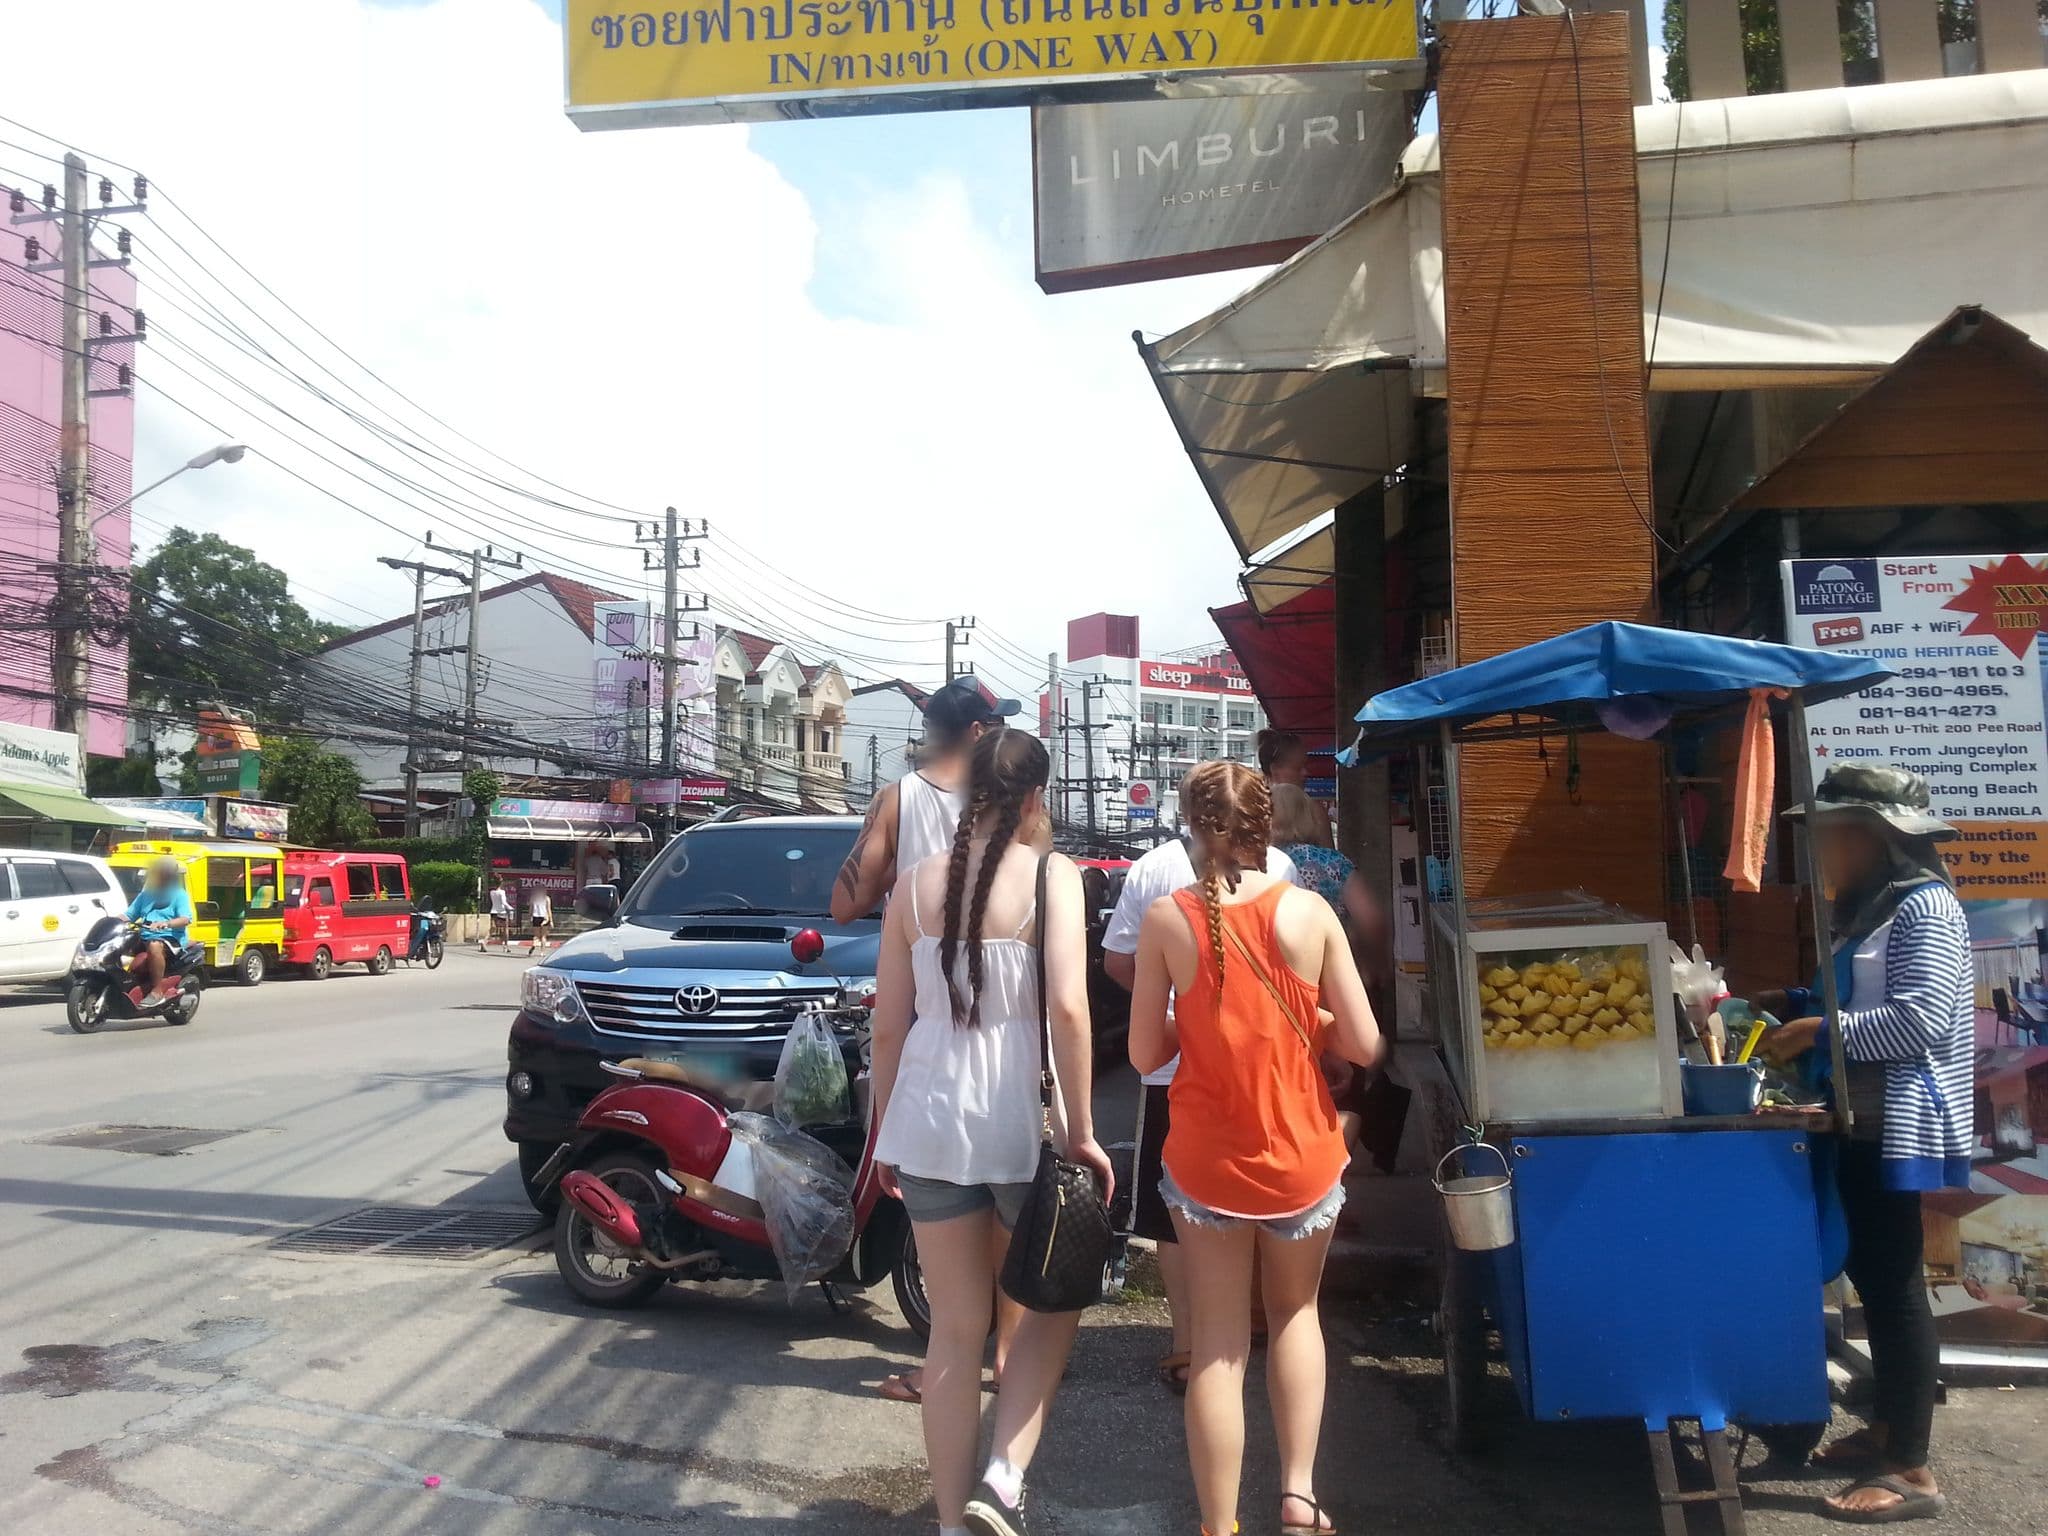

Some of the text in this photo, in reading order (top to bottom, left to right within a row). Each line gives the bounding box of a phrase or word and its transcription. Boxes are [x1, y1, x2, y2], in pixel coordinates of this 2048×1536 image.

[591, 0, 955, 49] ซอยฟาประทาน
[964, 37, 1074, 77] (ONE
[1094, 29, 1217, 66] WAY)
[1070, 109, 1366, 187] LIMBURI
[1162, 180, 1280, 207] HOMETEL
[1884, 563, 1938, 577] Start
[1809, 582, 1865, 594] PATONG
[1903, 581, 1953, 594] From
[1800, 592, 1875, 606] HERITAGE
[1870, 620, 1962, 634] ABF + WiFi
[1992, 611, 2040, 629] THB
[1816, 625, 1858, 640] Free
[1915, 646, 2000, 657] HERITAGE
[1149, 666, 1192, 689] sleep
[1898, 665, 2025, 679] 294-181 to 3
[1859, 704, 1997, 719] 081-841-4273
[1810, 722, 2043, 736] At On Rath U-Thit 200 Pee Road
[1, 744, 70, 767] Adam's Apple
[1835, 742, 2028, 758] 200m. From Jungceylon
[1970, 760, 2038, 775] Complex
[681, 786, 726, 797] EXCHANGE
[1930, 782, 2038, 798] atong Beach
[1942, 806, 1967, 817] Soi
[1974, 806, 2042, 817] BANGLA
[1969, 851, 1993, 866] by
[1999, 851, 2030, 863] the
